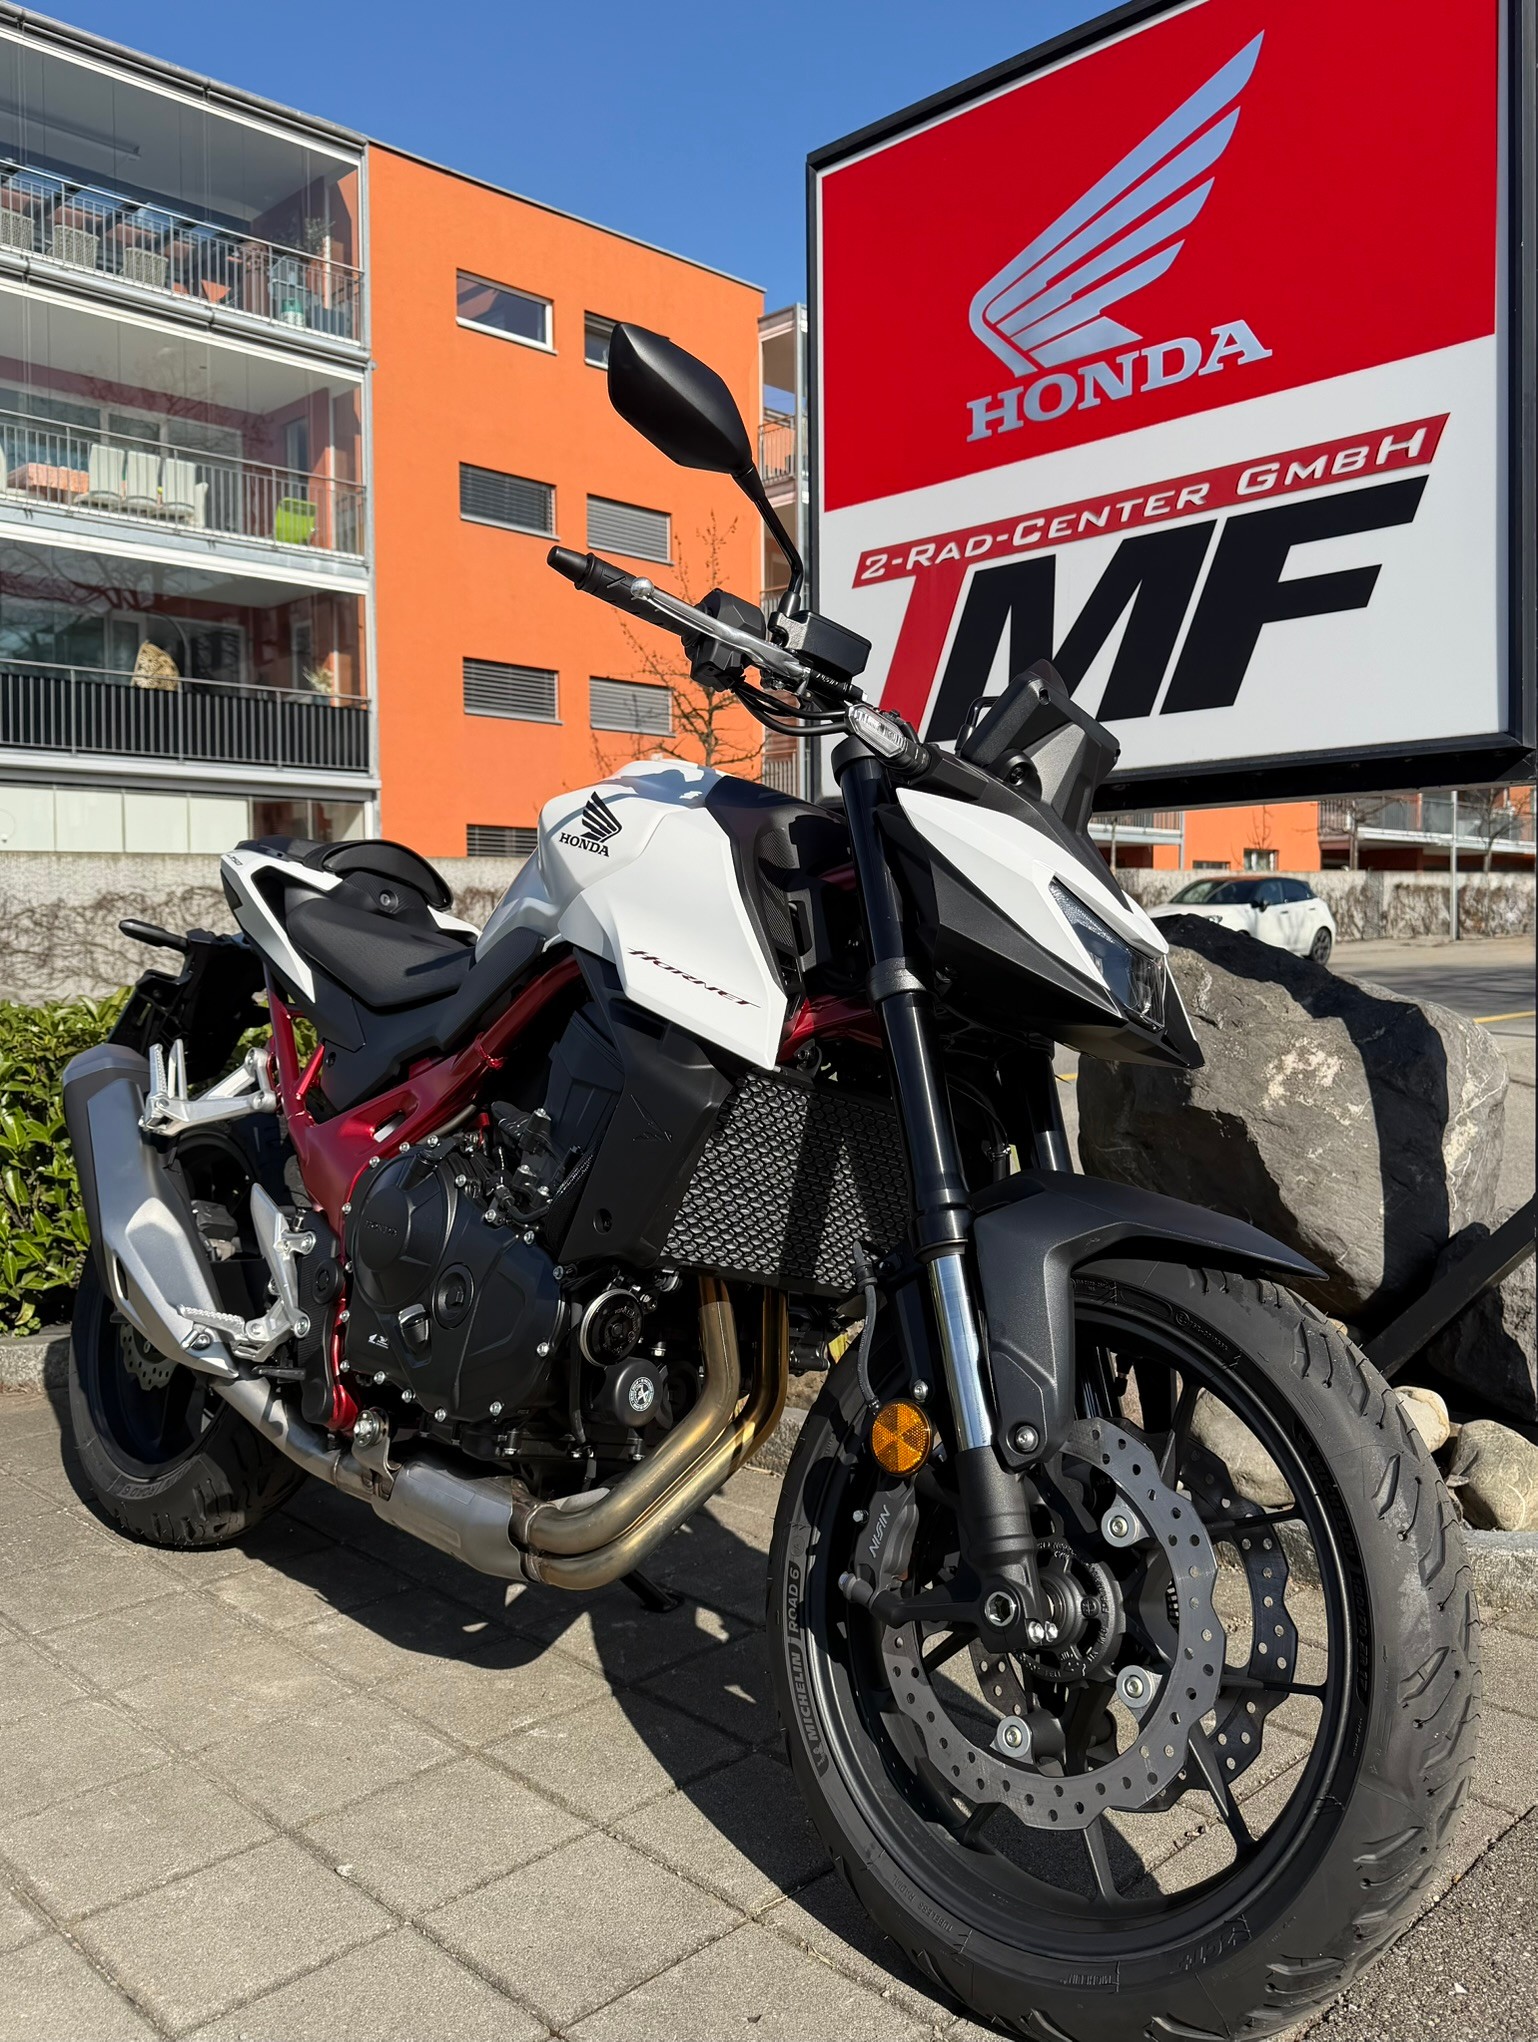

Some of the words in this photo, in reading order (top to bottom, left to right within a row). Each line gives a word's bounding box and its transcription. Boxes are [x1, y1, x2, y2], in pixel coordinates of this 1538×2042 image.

[966, 319, 1272, 442] HONDA
[873, 474, 1430, 744] TMF
[559, 832, 610, 858] HONDA
[790, 1567, 800, 1580] 6
[788, 1582, 799, 1633] ROAD
[791, 1652, 818, 1742] MICHELIN
[892, 1873, 916, 1902] RADIAL
